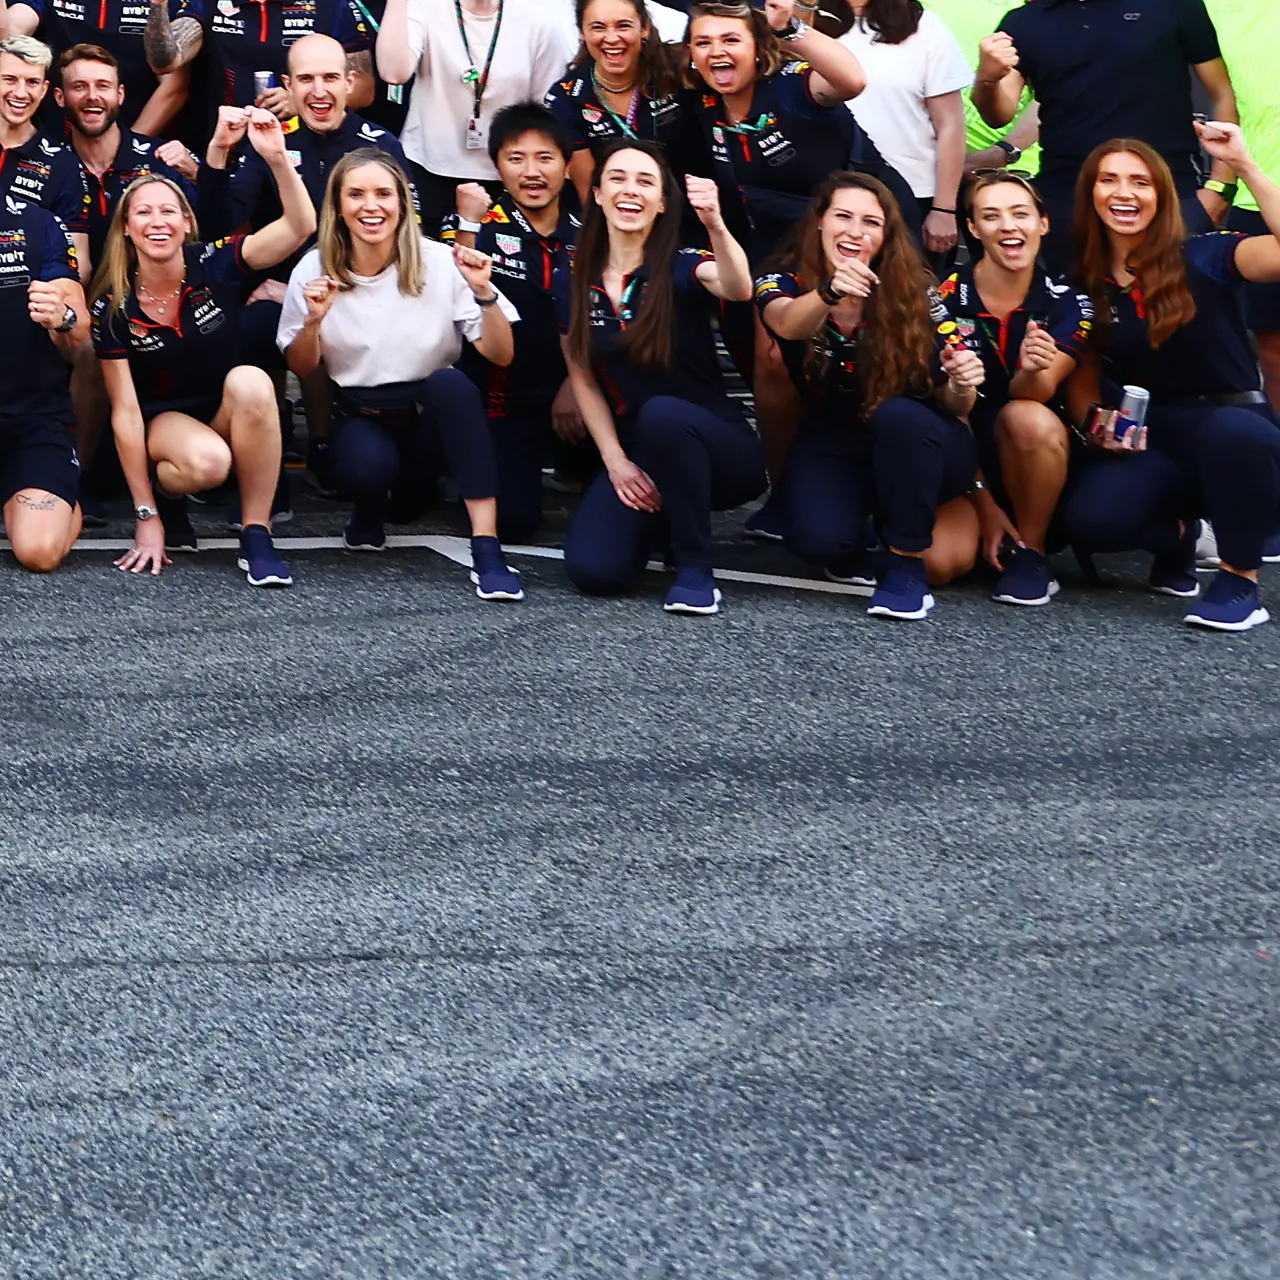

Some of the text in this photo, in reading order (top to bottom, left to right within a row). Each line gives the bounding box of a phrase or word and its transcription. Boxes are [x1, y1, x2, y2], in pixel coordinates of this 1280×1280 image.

[284, 18, 315, 27] BYBIT
[758, 131, 785, 149] BYBIT
[761, 140, 791, 157] HONDA
[14, 175, 44, 191] BYBIT
[10, 186, 42, 201] HONDA
[511, 210, 532, 233] zoom
[492, 266, 527, 280] ORACLE
[960, 283, 968, 306] zoom
[195, 307, 223, 326] HONDA
